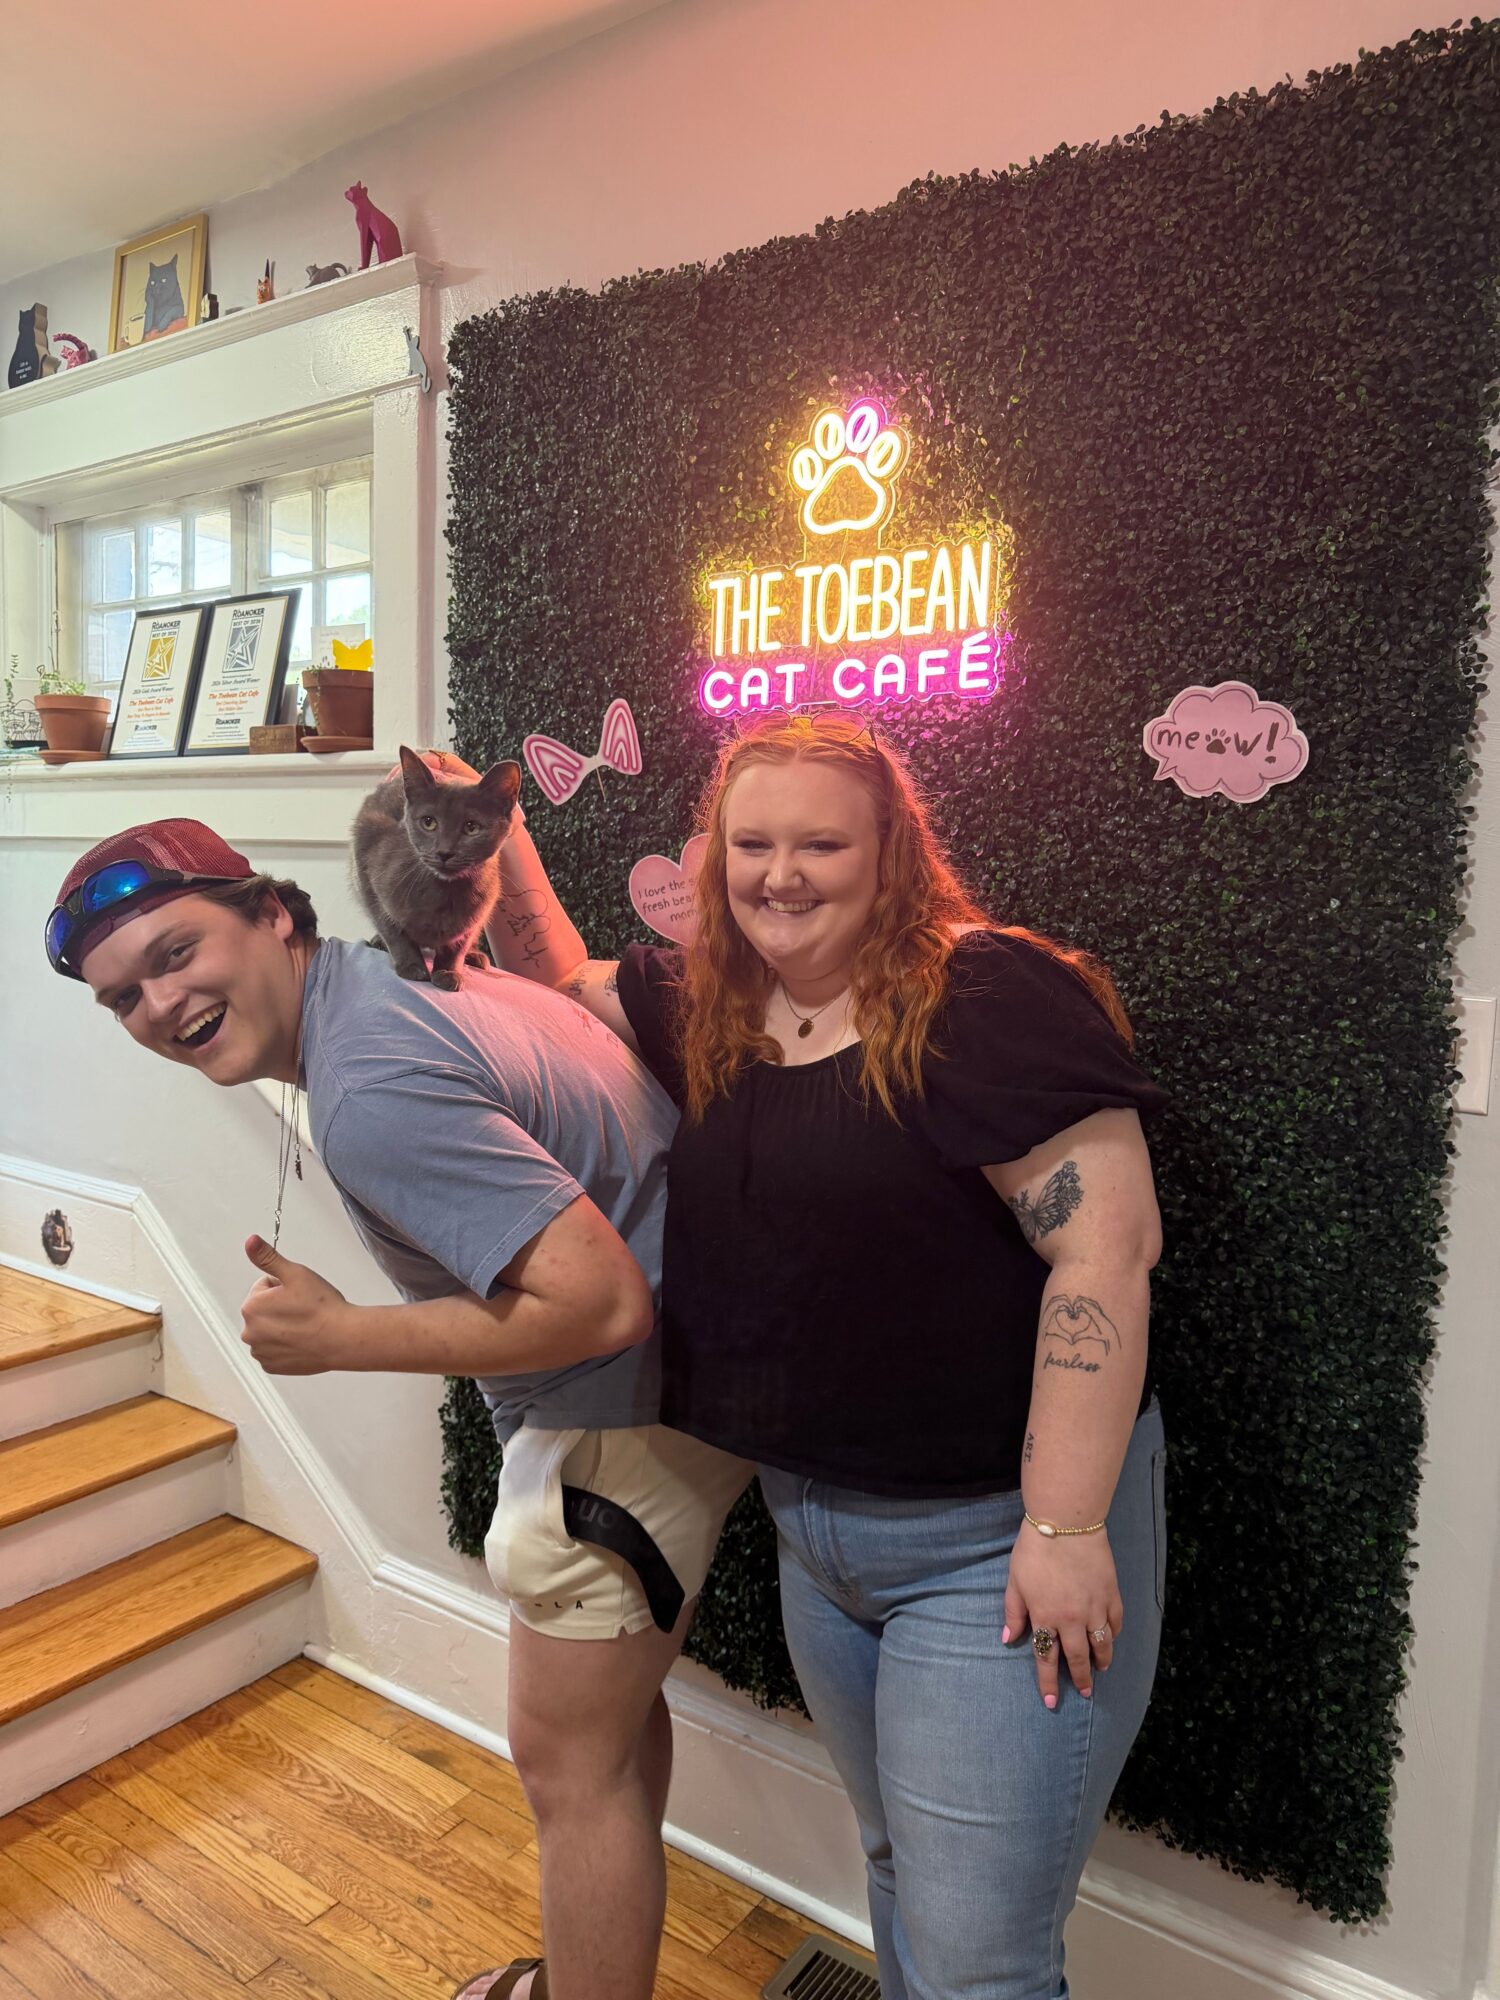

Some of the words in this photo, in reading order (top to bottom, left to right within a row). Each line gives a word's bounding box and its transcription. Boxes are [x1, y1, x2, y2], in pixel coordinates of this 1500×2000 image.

[709, 571, 783, 656] THE
[795, 541, 990, 646] TOEBEAN
[232, 608, 265, 617] ROANOKER
[152, 620, 181, 629] ROANOKER
[704, 663, 805, 709] CAT
[832, 631, 991, 698] CAFÉ
[645, 885, 666, 897] love
[669, 880, 685, 891] the
[642, 898, 670, 914] fresh
[672, 895, 692, 906] bea
[1043, 1352, 1102, 1372] fearless
